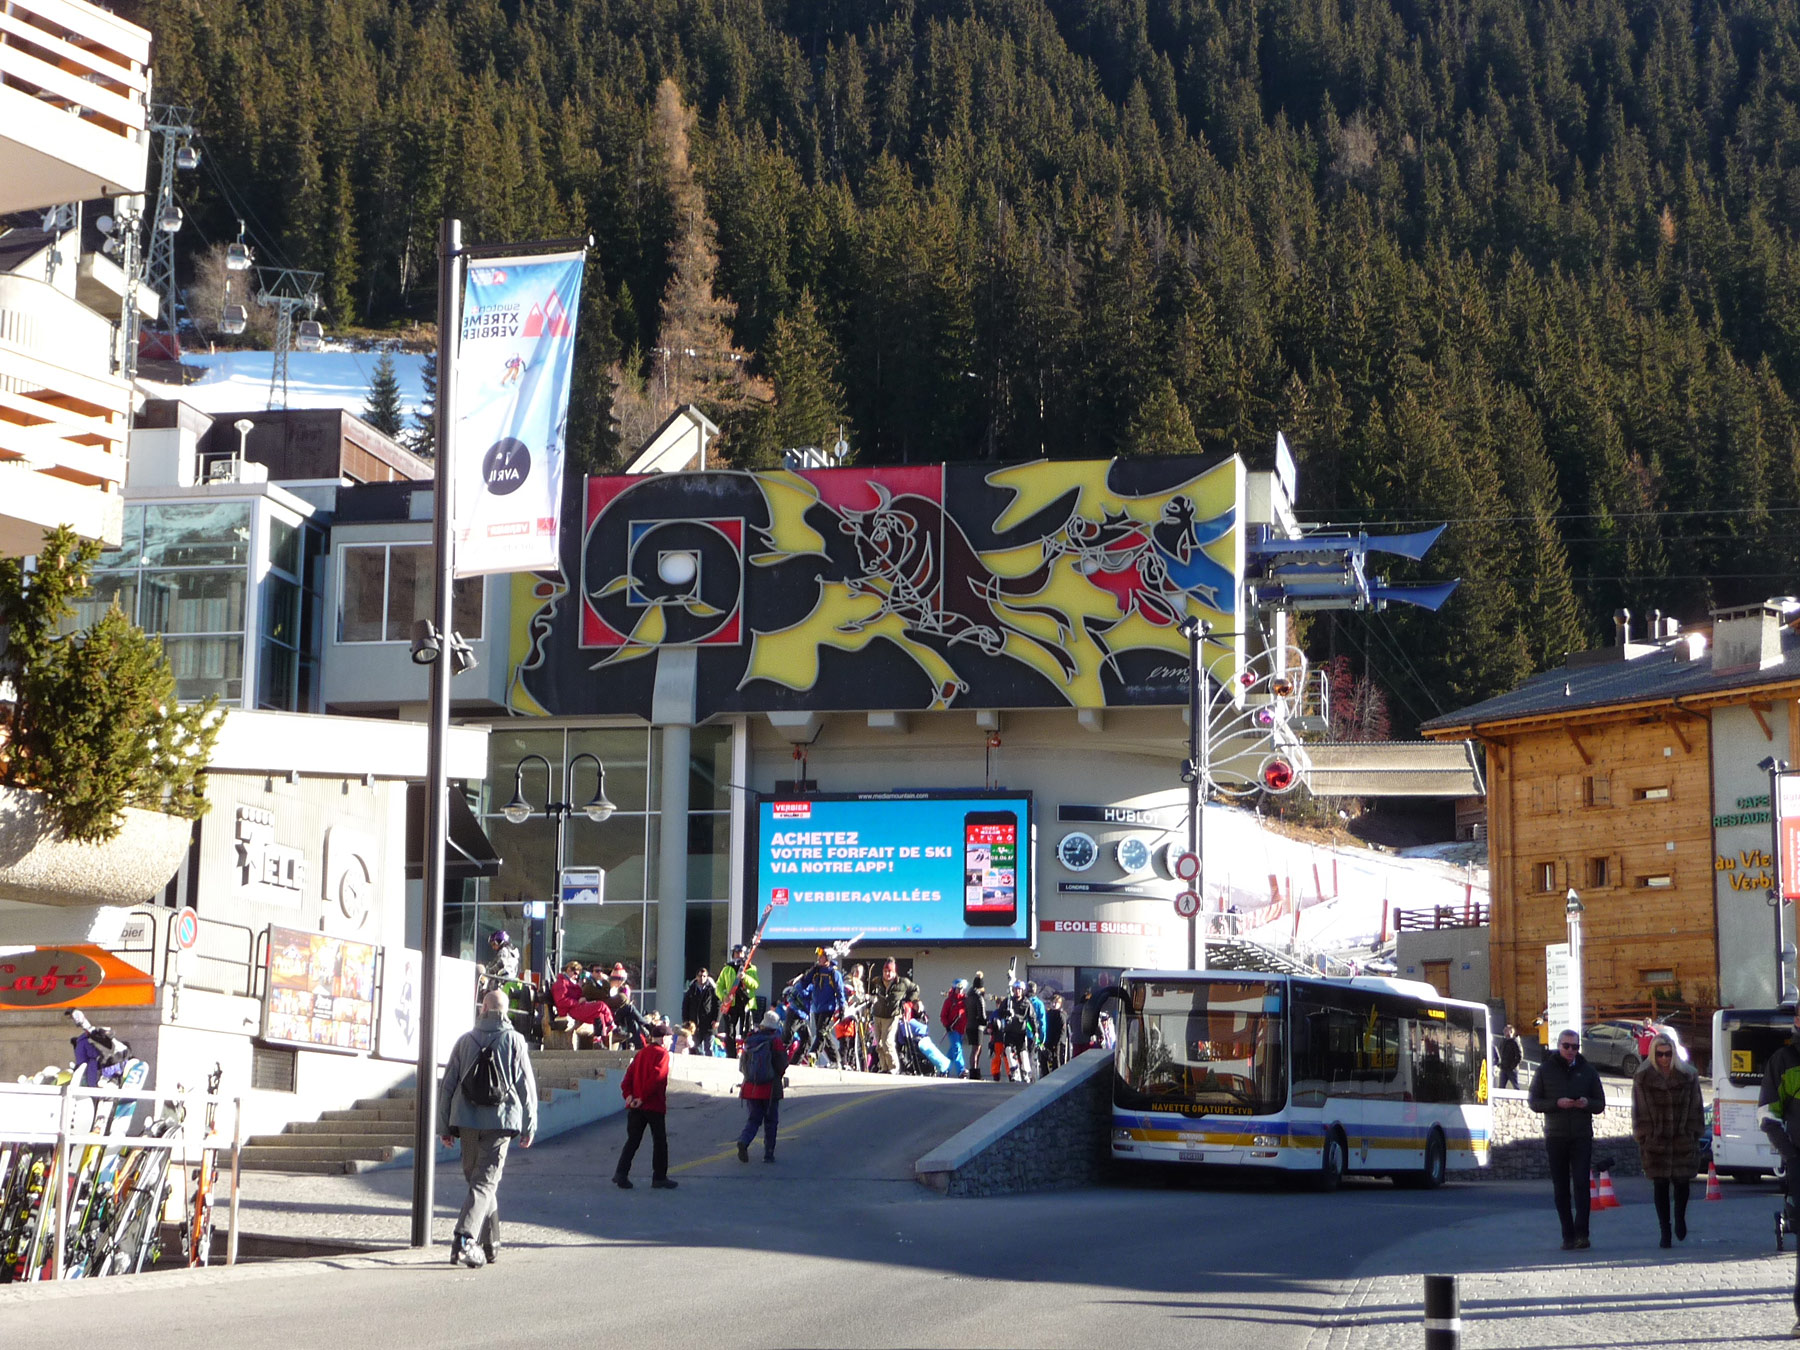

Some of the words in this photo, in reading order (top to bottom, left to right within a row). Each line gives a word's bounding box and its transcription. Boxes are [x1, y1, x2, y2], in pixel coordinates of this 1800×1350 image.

[1736, 795, 1770, 808] CAFE
[1105, 809, 1160, 824] HUBLOT
[771, 832, 858, 845] ACHETEZ
[771, 848, 822, 860] VOTRE
[827, 847, 895, 859] FORFAIT
[899, 847, 920, 858] DE
[925, 847, 952, 858] SKI
[771, 862, 798, 873] VIA
[802, 862, 852, 873] NOTRE
[793, 888, 941, 904] VERBIER4VALLÉES
[1054, 921, 1097, 932] ECOLE
[1151, 1103, 1190, 1112] NAVETTE
